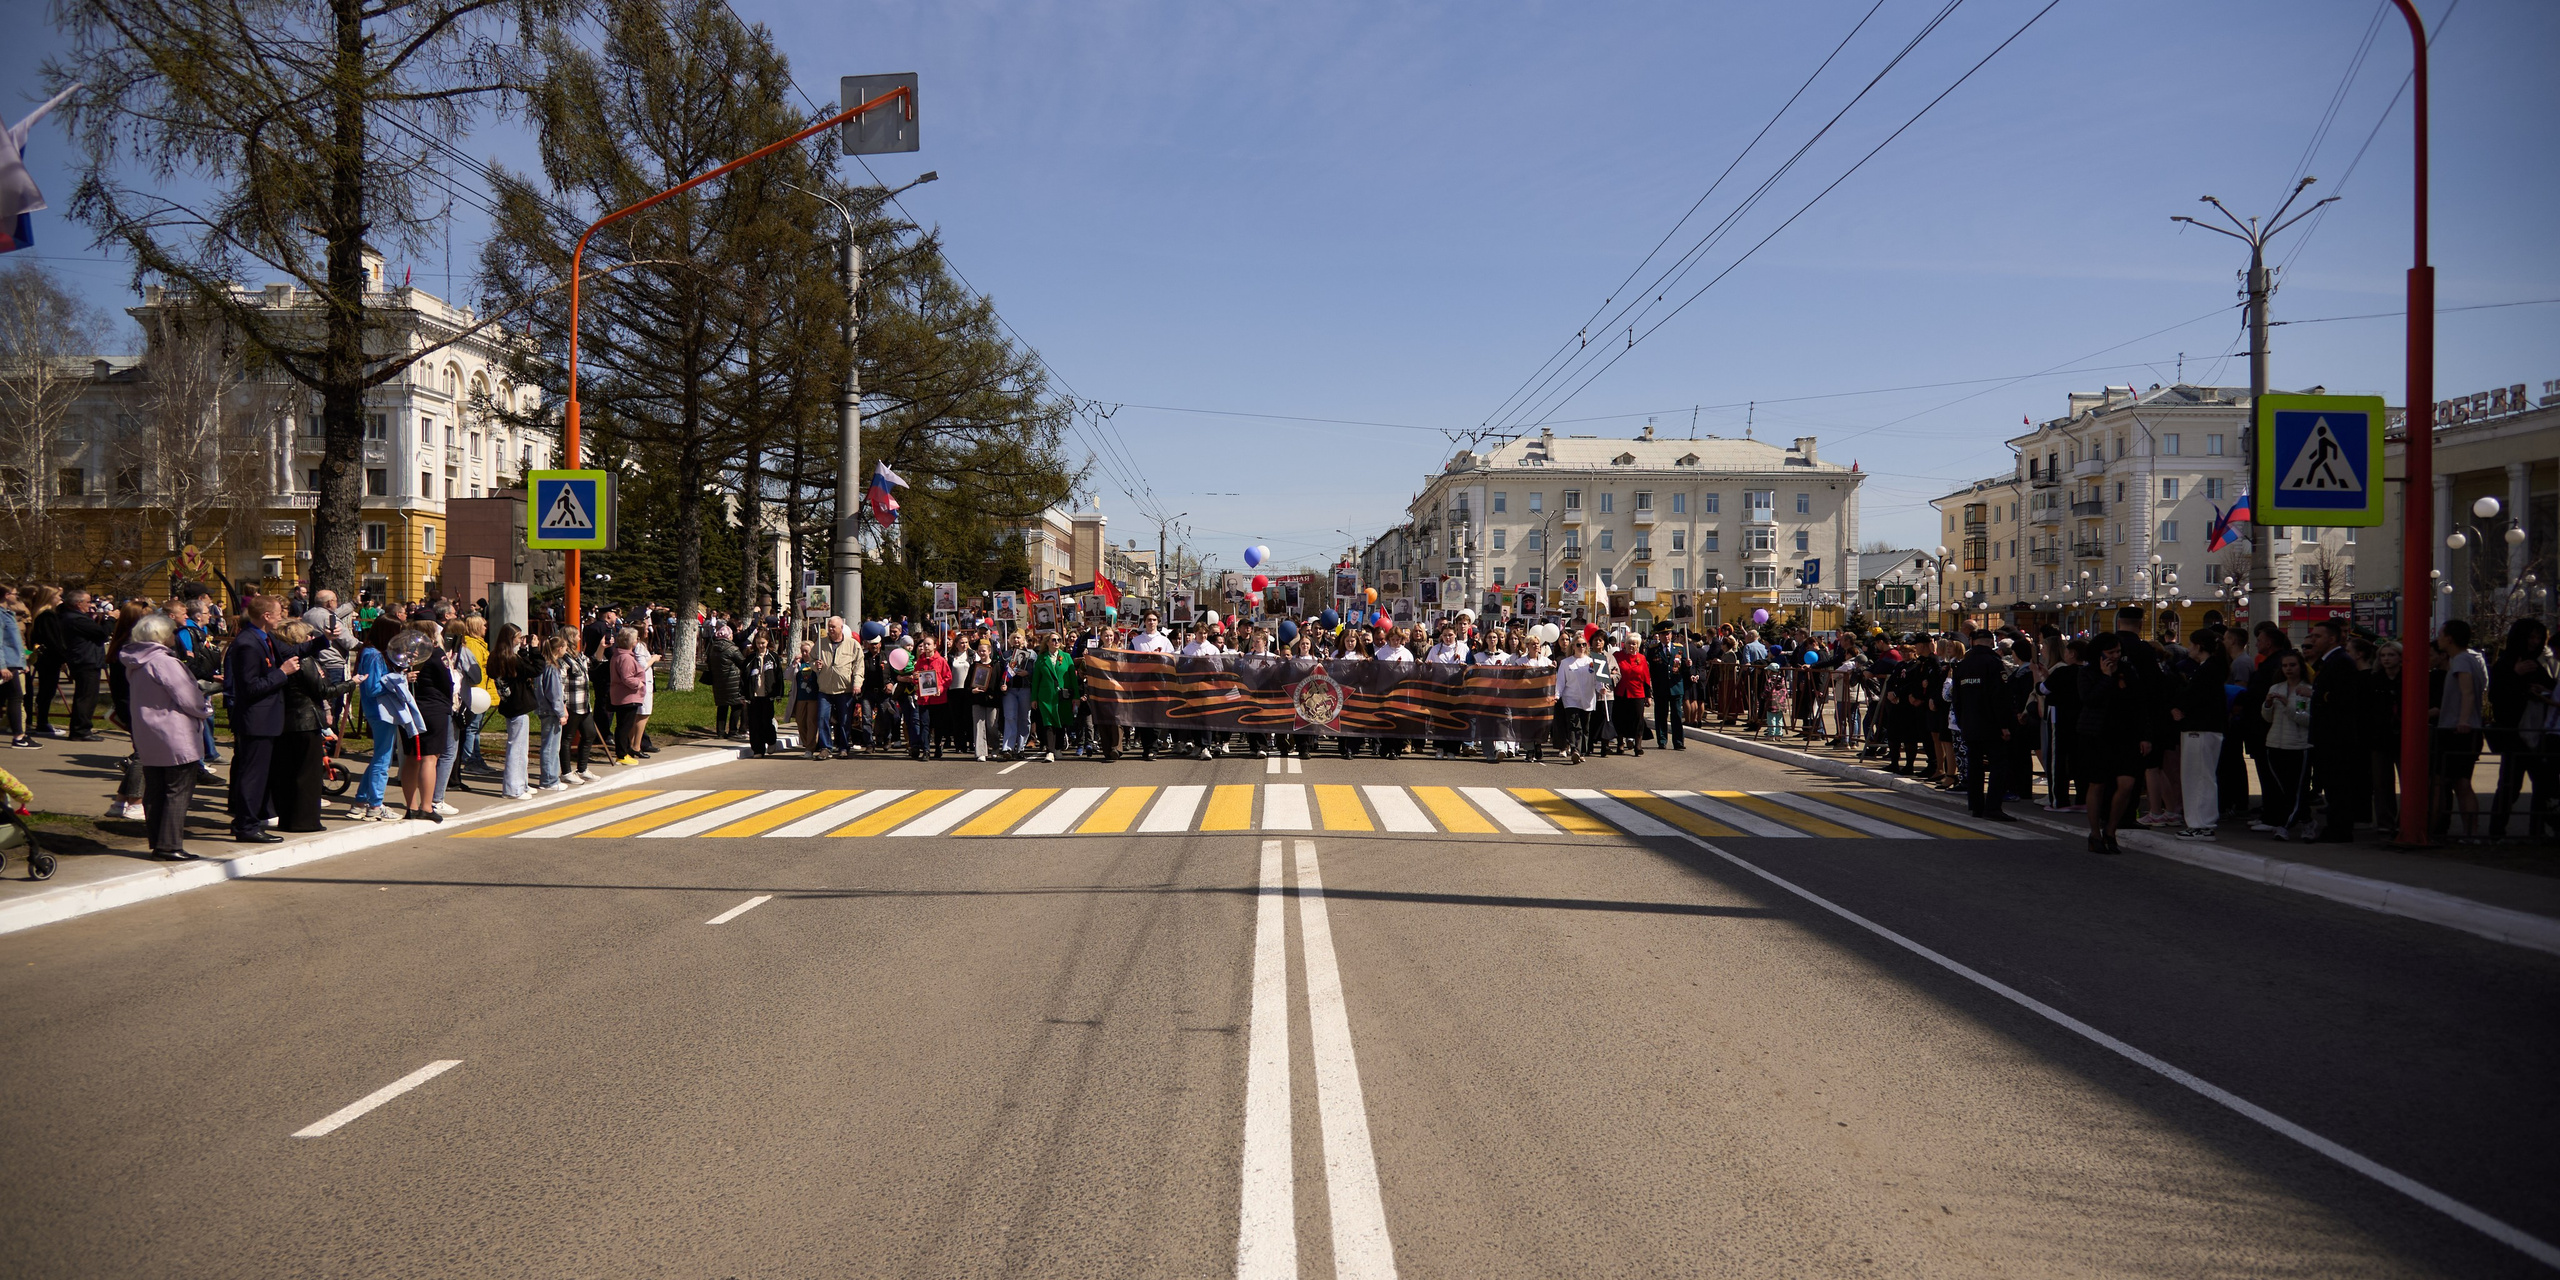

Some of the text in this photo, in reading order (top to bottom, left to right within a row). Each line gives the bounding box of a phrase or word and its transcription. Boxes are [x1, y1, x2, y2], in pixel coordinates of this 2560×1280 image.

[2432, 384, 2525, 427] ОБЕДА
[1806, 562, 1817, 582] P
[2329, 609, 2351, 618] Сиб
[1961, 678, 1981, 686] ИЦИЯ
